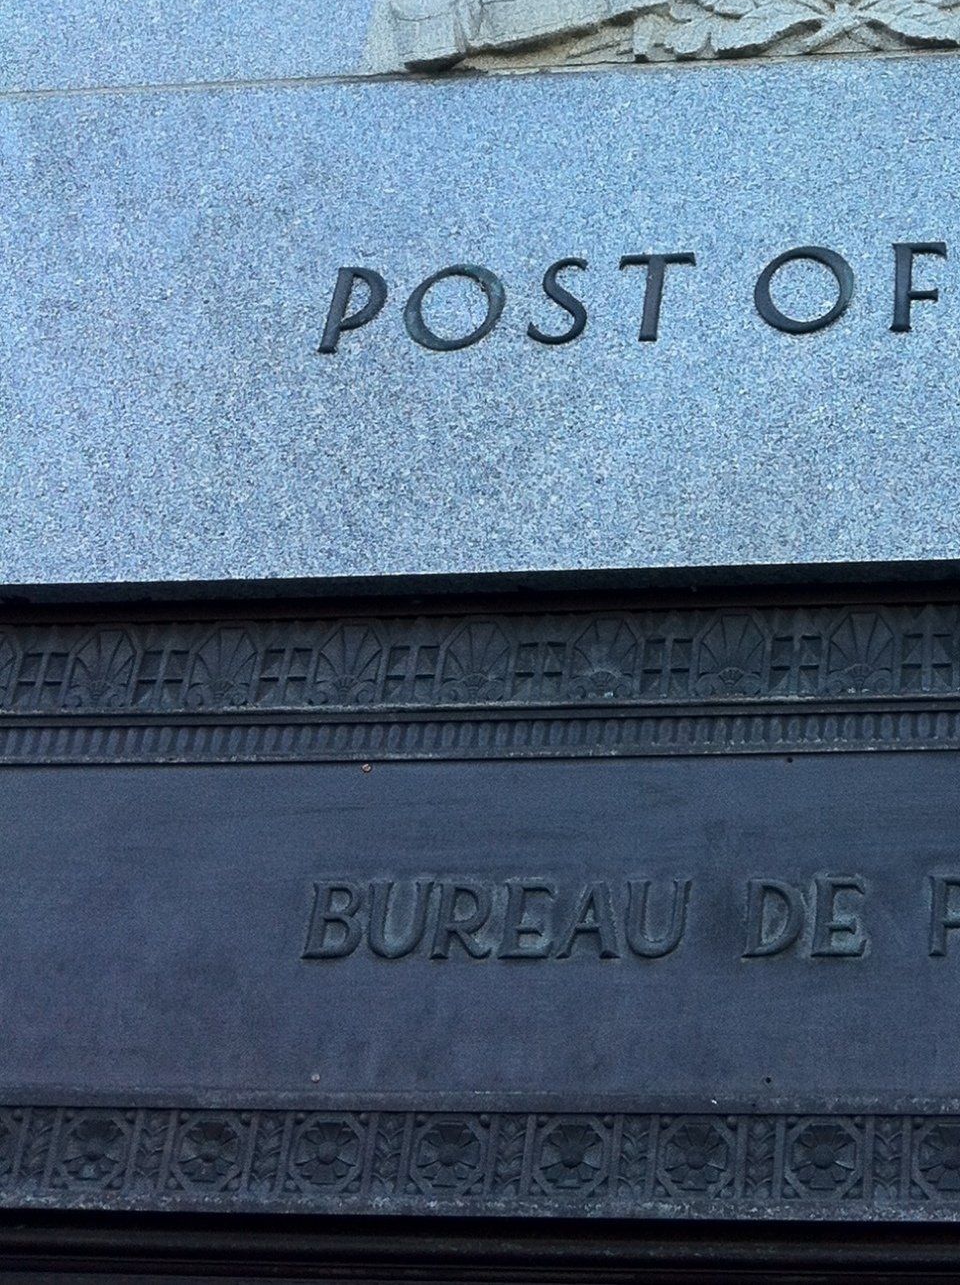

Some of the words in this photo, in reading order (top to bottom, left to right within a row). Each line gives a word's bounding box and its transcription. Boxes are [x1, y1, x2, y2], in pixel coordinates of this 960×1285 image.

[317, 251, 697, 355] POST
[300, 877, 692, 962] BUREAU
[740, 871, 872, 961] DE
